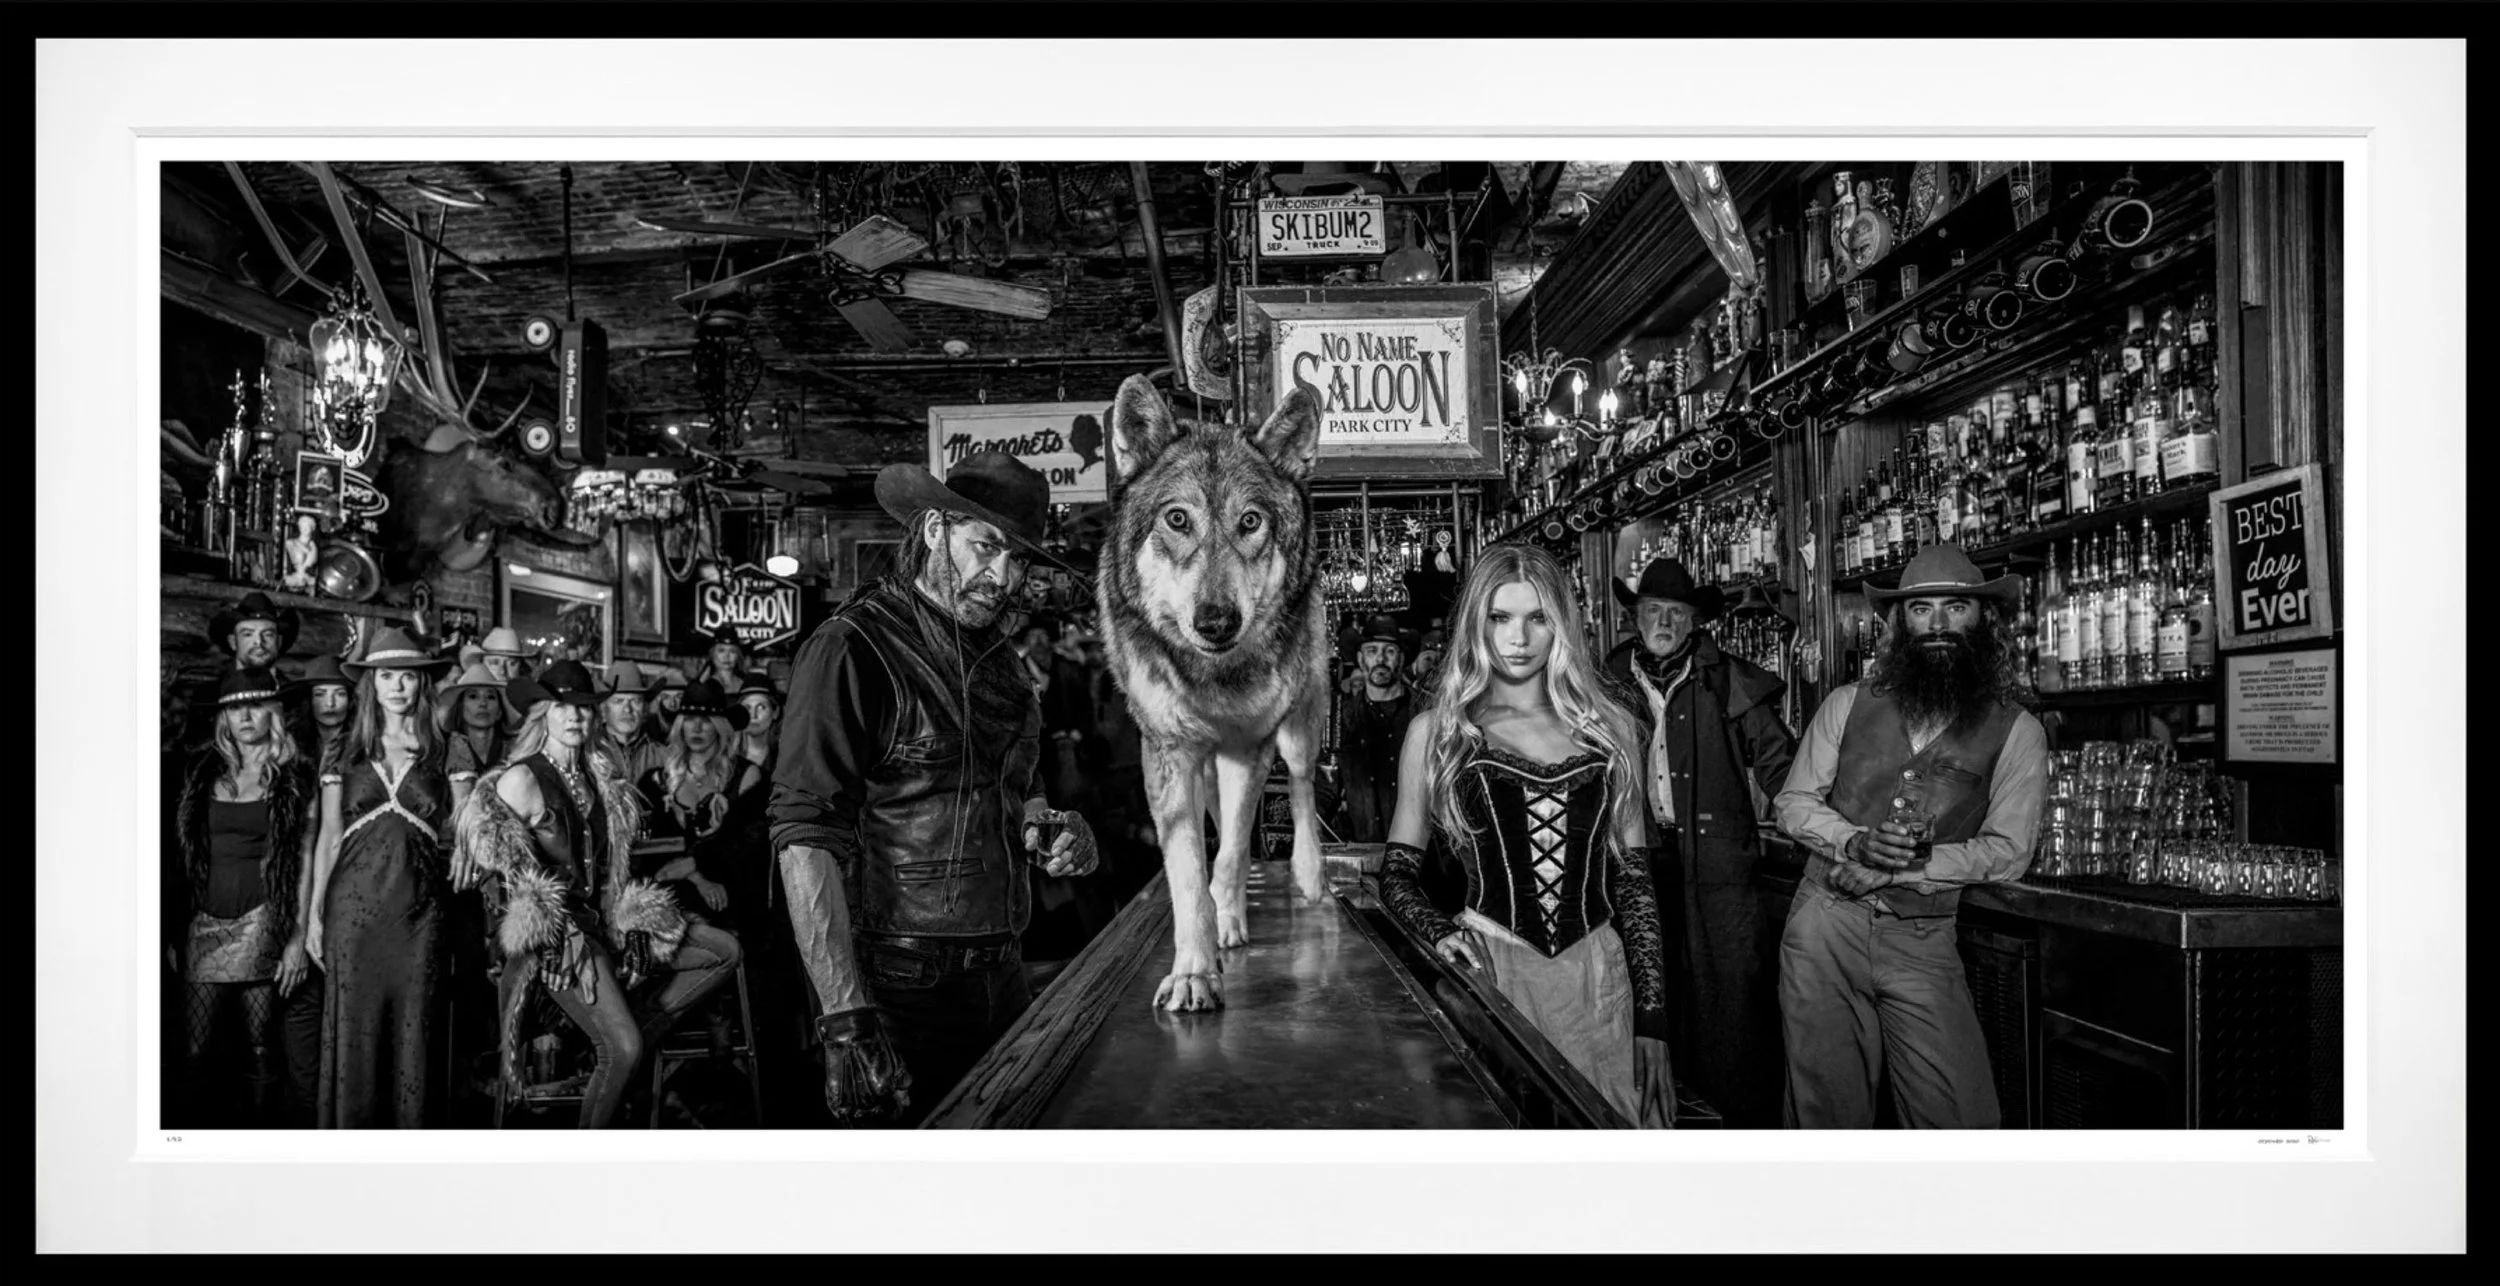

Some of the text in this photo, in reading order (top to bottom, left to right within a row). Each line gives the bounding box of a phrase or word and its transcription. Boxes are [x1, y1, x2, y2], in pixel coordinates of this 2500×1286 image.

[1263, 199, 1329, 210] WISCONSIN
[1272, 211, 1373, 241] SKIBUM2
[1267, 242, 1283, 252] SEP
[1306, 240, 1341, 249] TRUCK
[1292, 350, 1452, 428] SALOON
[1329, 418, 1413, 433] PARK CITY
[2235, 491, 2302, 544] BEST
[2247, 541, 2301, 590] day
[702, 586, 795, 628] SALOON
[2241, 587, 2310, 631] Ever
